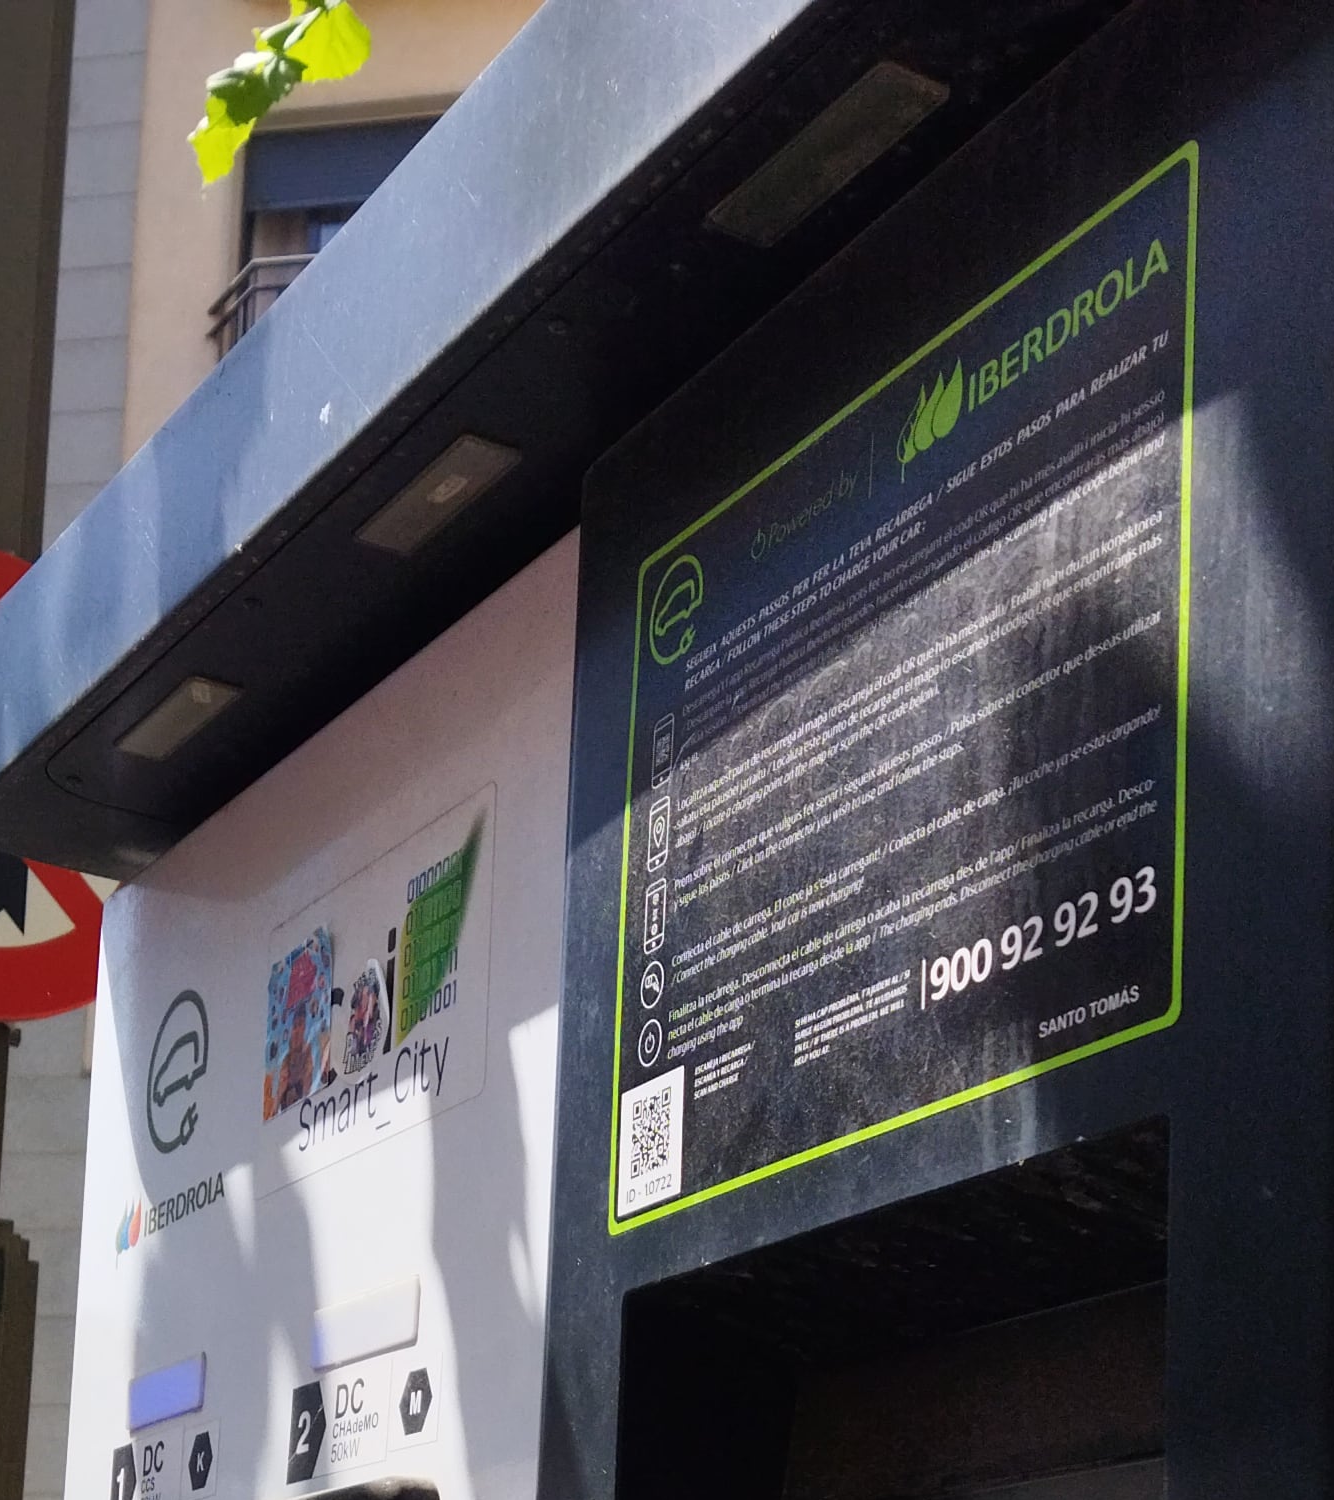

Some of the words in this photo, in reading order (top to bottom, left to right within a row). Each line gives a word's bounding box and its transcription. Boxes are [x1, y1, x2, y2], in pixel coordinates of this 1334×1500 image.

[967, 239, 1170, 414] IBERDROLA
[719, 612, 756, 649] AQUESTS
[758, 589, 789, 623] PASSOS
[791, 575, 810, 600] PER
[812, 561, 829, 586] FER
[831, 551, 845, 573] LA
[848, 532, 872, 561] TEVA
[945, 460, 976, 495] SIGUE
[979, 436, 1012, 472] ESTOS
[1016, 409, 1051, 447] PASOS
[1055, 385, 1085, 420] PARA
[1089, 343, 1147, 397] REALIZAR
[1152, 328, 1169, 354] TU
[838, 464, 861, 506] by
[684, 655, 721, 692] RECARGA
[726, 628, 760, 663] FOLLOW
[762, 608, 790, 639] THESE
[790, 590, 817, 621] STEPS
[819, 580, 832, 602] TO
[832, 554, 870, 593] CHARGE
[872, 534, 900, 566] YOUR
[692, 859, 712, 879] sobre
[712, 854, 721, 867] el
[720, 833, 758, 863] connector
[758, 827, 774, 845] que
[910, 732, 941, 759] passos
[950, 710, 976, 735] Pulsa
[975, 694, 1004, 721] sobre
[1005, 688, 1015, 704] el
[1015, 662, 1061, 698] conector
[1062, 653, 1082, 675] que
[1083, 628, 1121, 660] deseas
[1122, 606, 1161, 639] utilizar
[670, 939, 705, 967] Connecta
[705, 935, 712, 949] el
[712, 925, 732, 945] cable
[732, 920, 742, 935] de
[773, 899, 782, 913] El
[837, 847, 881, 882] carregant!
[888, 823, 926, 854] Conecta
[926, 818, 936, 834] el
[936, 805, 962, 828] cable
[963, 797, 976, 815] de
[976, 784, 1006, 811] carga.
[668, 997, 697, 1021] Finalitza
[697, 994, 704, 1007] la
[741, 951, 791, 985] Desconnecta
[790, 947, 800, 961] el
[799, 936, 822, 957] cable
[821, 930, 833, 946] de
[834, 914, 866, 943] càrrega
[874, 897, 901, 921] acaba
[901, 892, 910, 908] la
[911, 870, 955, 906] recàrrega
[956, 861, 974, 881] des
[974, 854, 988, 872] de
[1021, 818, 1060, 850] Finaliza
[1061, 813, 1072, 830] la
[928, 935, 993, 1004] 900
[999, 912, 1044, 974] 92
[1052, 887, 1099, 951] 92
[1107, 861, 1157, 927] 93
[667, 1020, 687, 1040] necta
[686, 1017, 695, 1031] el
[694, 1008, 714, 1027] cable
[713, 1003, 724, 1018] de
[723, 996, 744, 1016] carga
[750, 975, 781, 1001] termina
[781, 971, 789, 986] la
[788, 960, 819, 985] recarga
[819, 944, 845, 968] desde
[845, 940, 854, 955] la
[853, 935, 871, 955] app
[878, 920, 895, 939] The
[894, 901, 934, 935] charging
[675, 958, 704, 983] Connect
[703, 952, 716, 969] the
[716, 936, 747, 965] charging
[399, 976, 457, 1034] 01101001
[1038, 1001, 1086, 1039] SANTO
[1089, 979, 1140, 1019] TOMÁS
[144, 1172, 225, 1237] IBERDROLA
[626, 1188, 636, 1205] ID
[297, 1410, 311, 1454] 2
[332, 1411, 379, 1438] CHAdeMO
[409, 1390, 422, 1416] M
[335, 1378, 365, 1419] DC
[141, 1476, 156, 1494] CCS
[196, 1458, 205, 1473] K
[143, 1441, 165, 1477] DC
[330, 1438, 361, 1463] 50kW
